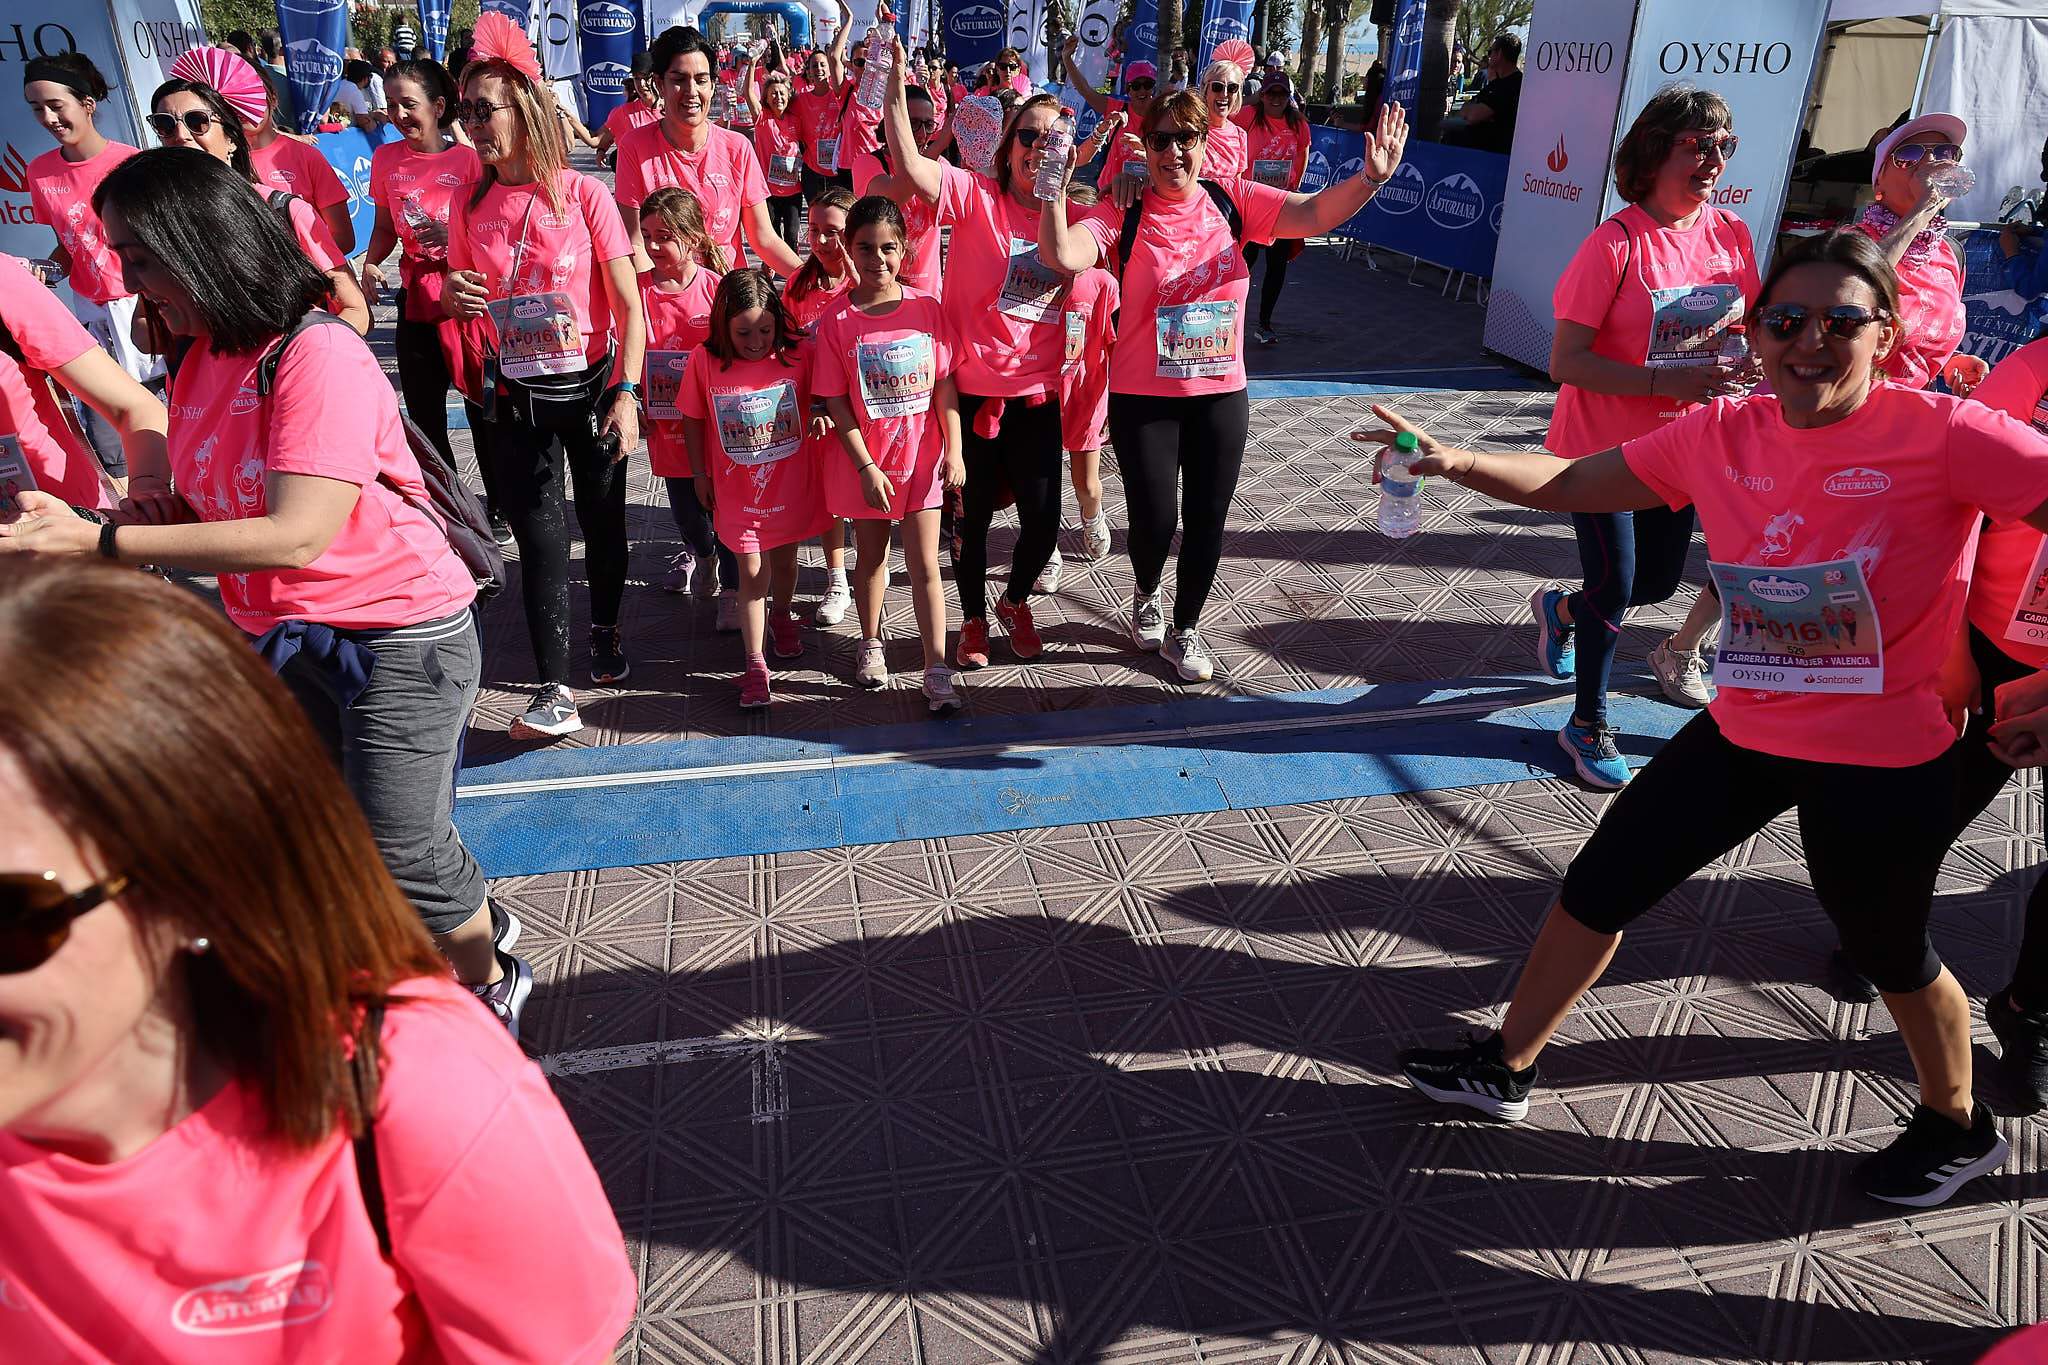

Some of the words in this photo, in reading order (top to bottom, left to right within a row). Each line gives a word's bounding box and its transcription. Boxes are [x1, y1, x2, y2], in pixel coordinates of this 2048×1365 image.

[583, 14, 632, 28] ASTURIANA
[133, 20, 200, 59] OYSHO
[1537, 41, 1613, 74] OYSHO
[1659, 41, 1792, 75] OYSHO
[588, 73, 624, 86] ASTURI
[1523, 172, 1583, 203] Santander
[1429, 191, 1476, 220] ASTURIANA
[477, 219, 511, 232] OYSHO
[1683, 297, 1718, 307] ASTURIANA
[515, 306, 546, 317] ASTURIANA
[1973, 316, 2036, 339] CENTRAL
[524, 329, 552, 345] 016
[1185, 336, 1214, 349] 016
[1651, 352, 1677, 360] CARRERA
[509, 365, 534, 374] OYSHO
[889, 372, 918, 388] 016
[710, 385, 742, 395] OYSHO
[739, 400, 772, 412] ASTURIANA
[873, 405, 900, 414] OYSHO
[656, 409, 681, 417] OYSHO
[746, 421, 775, 438] 016
[734, 453, 759, 461] OYSHO
[1725, 465, 1774, 492] OYSHO
[1828, 479, 1885, 491] ASTURIANA
[1824, 570, 1842, 580] 20
[1752, 584, 1807, 597] ASTURIANA
[2023, 613, 2048, 625] CARR
[1768, 619, 1823, 642] 016
[1726, 653, 1767, 665] CARRERA
[1769, 655, 1780, 665] DE
[1782, 656, 1794, 666] LA
[1795, 656, 1824, 667] MUJER
[1830, 656, 1871, 666] VALENCIA
[1732, 668, 1785, 683] OYSHO
[1816, 675, 1864, 685] Santander
